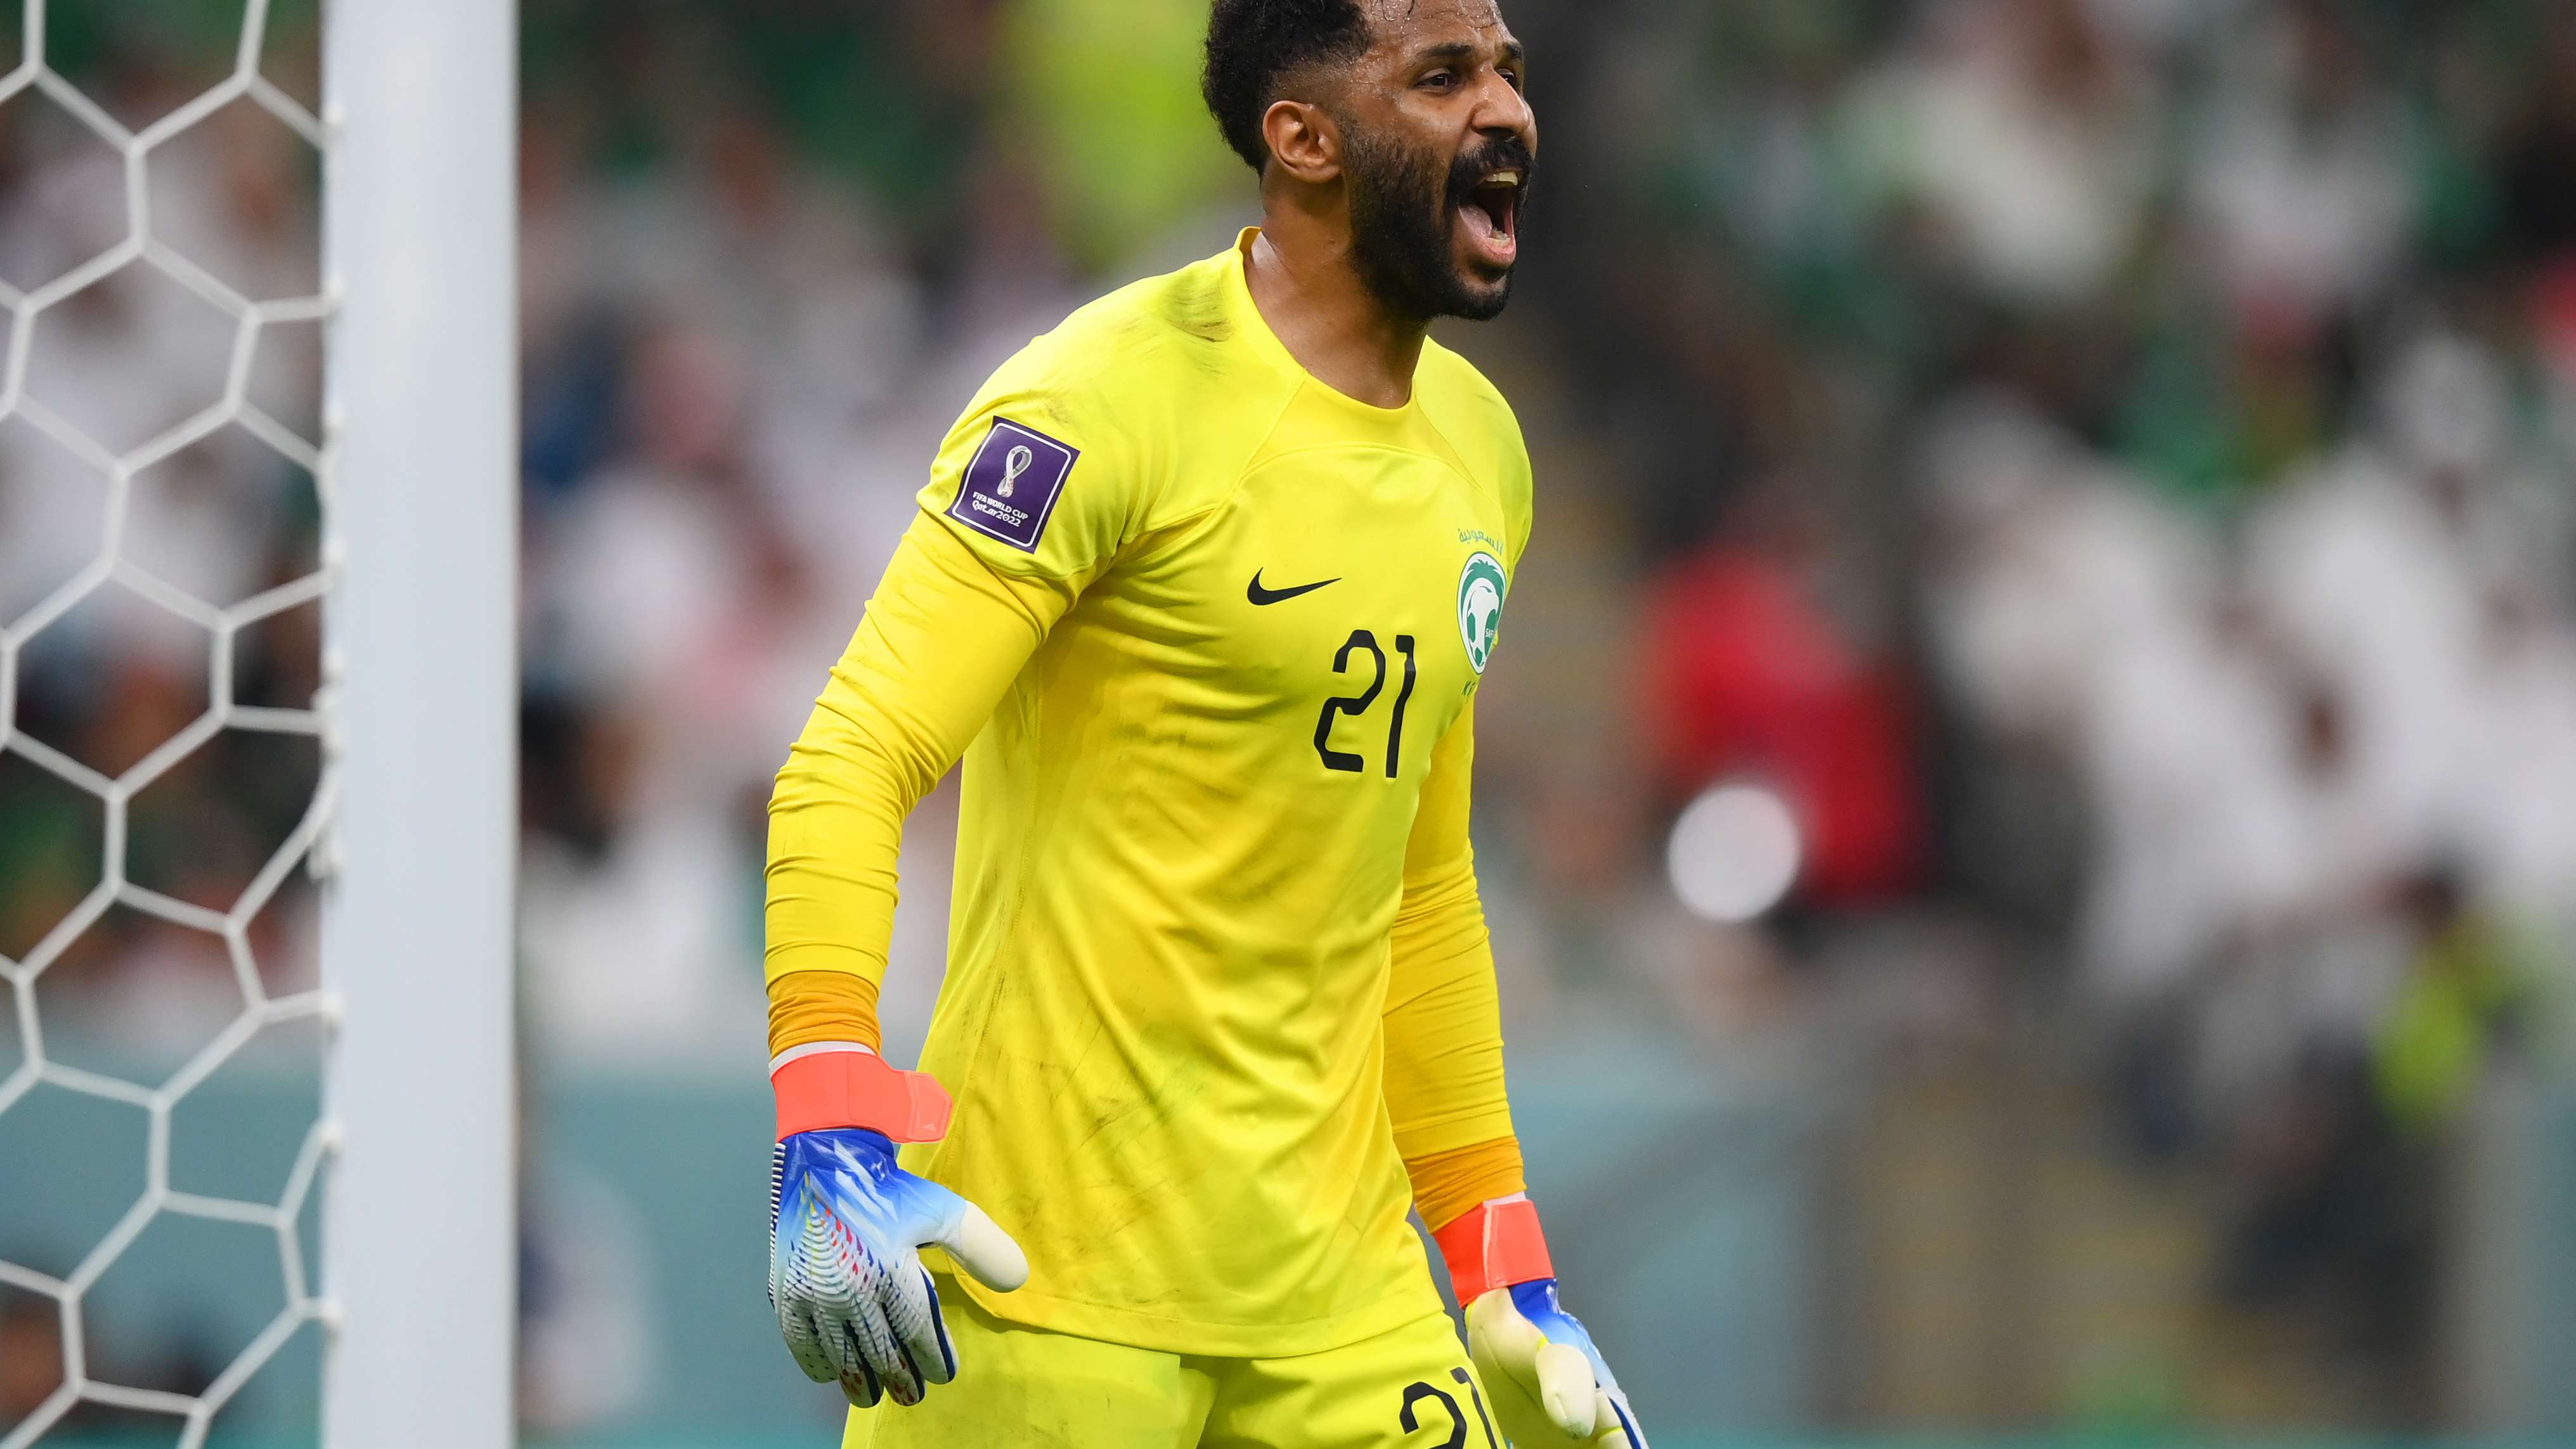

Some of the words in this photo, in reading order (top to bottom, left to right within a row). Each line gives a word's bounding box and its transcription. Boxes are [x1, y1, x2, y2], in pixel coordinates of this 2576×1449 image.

[973, 491, 987, 503] FIFA
[987, 498, 1012, 513] WORLD
[1012, 509, 1028, 519] CUP
[1314, 630, 1416, 779] 21
